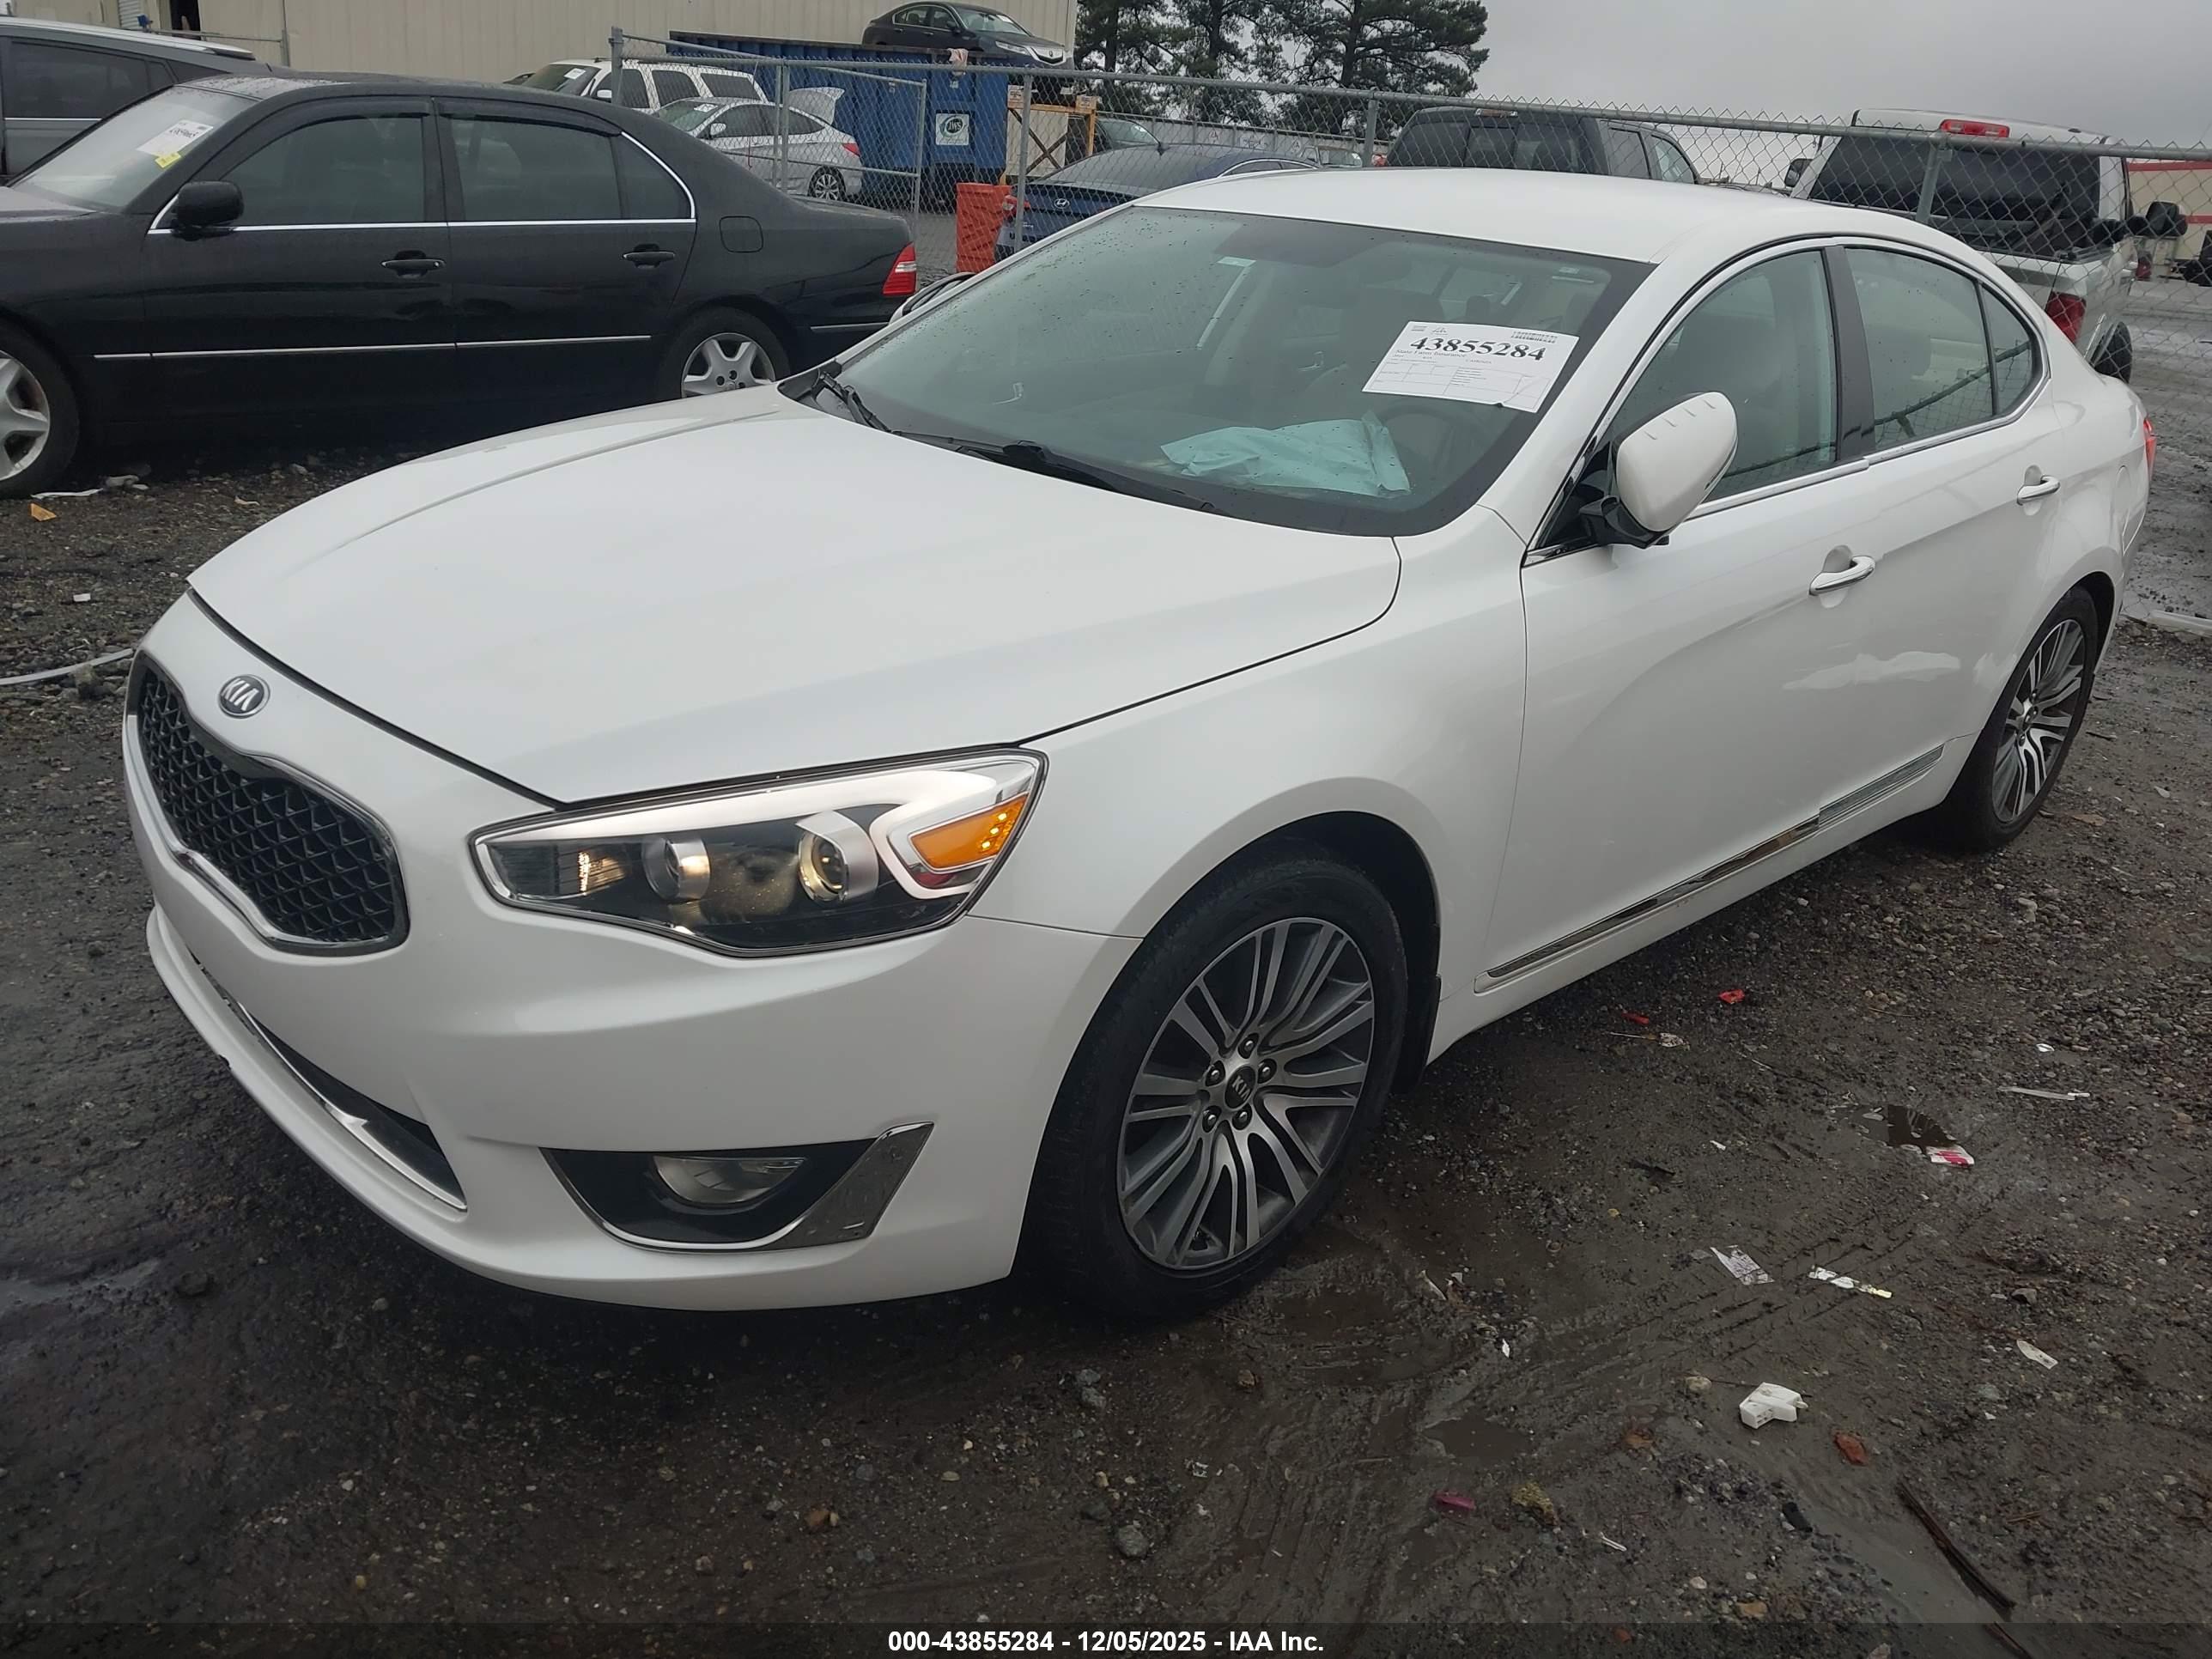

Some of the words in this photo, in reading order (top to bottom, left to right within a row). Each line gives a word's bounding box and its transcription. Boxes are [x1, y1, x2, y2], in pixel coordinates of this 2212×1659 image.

[1410, 337, 1547, 361] 43855284
[220, 678, 260, 712] KIA
[1231, 1075, 1251, 1102] KIA
